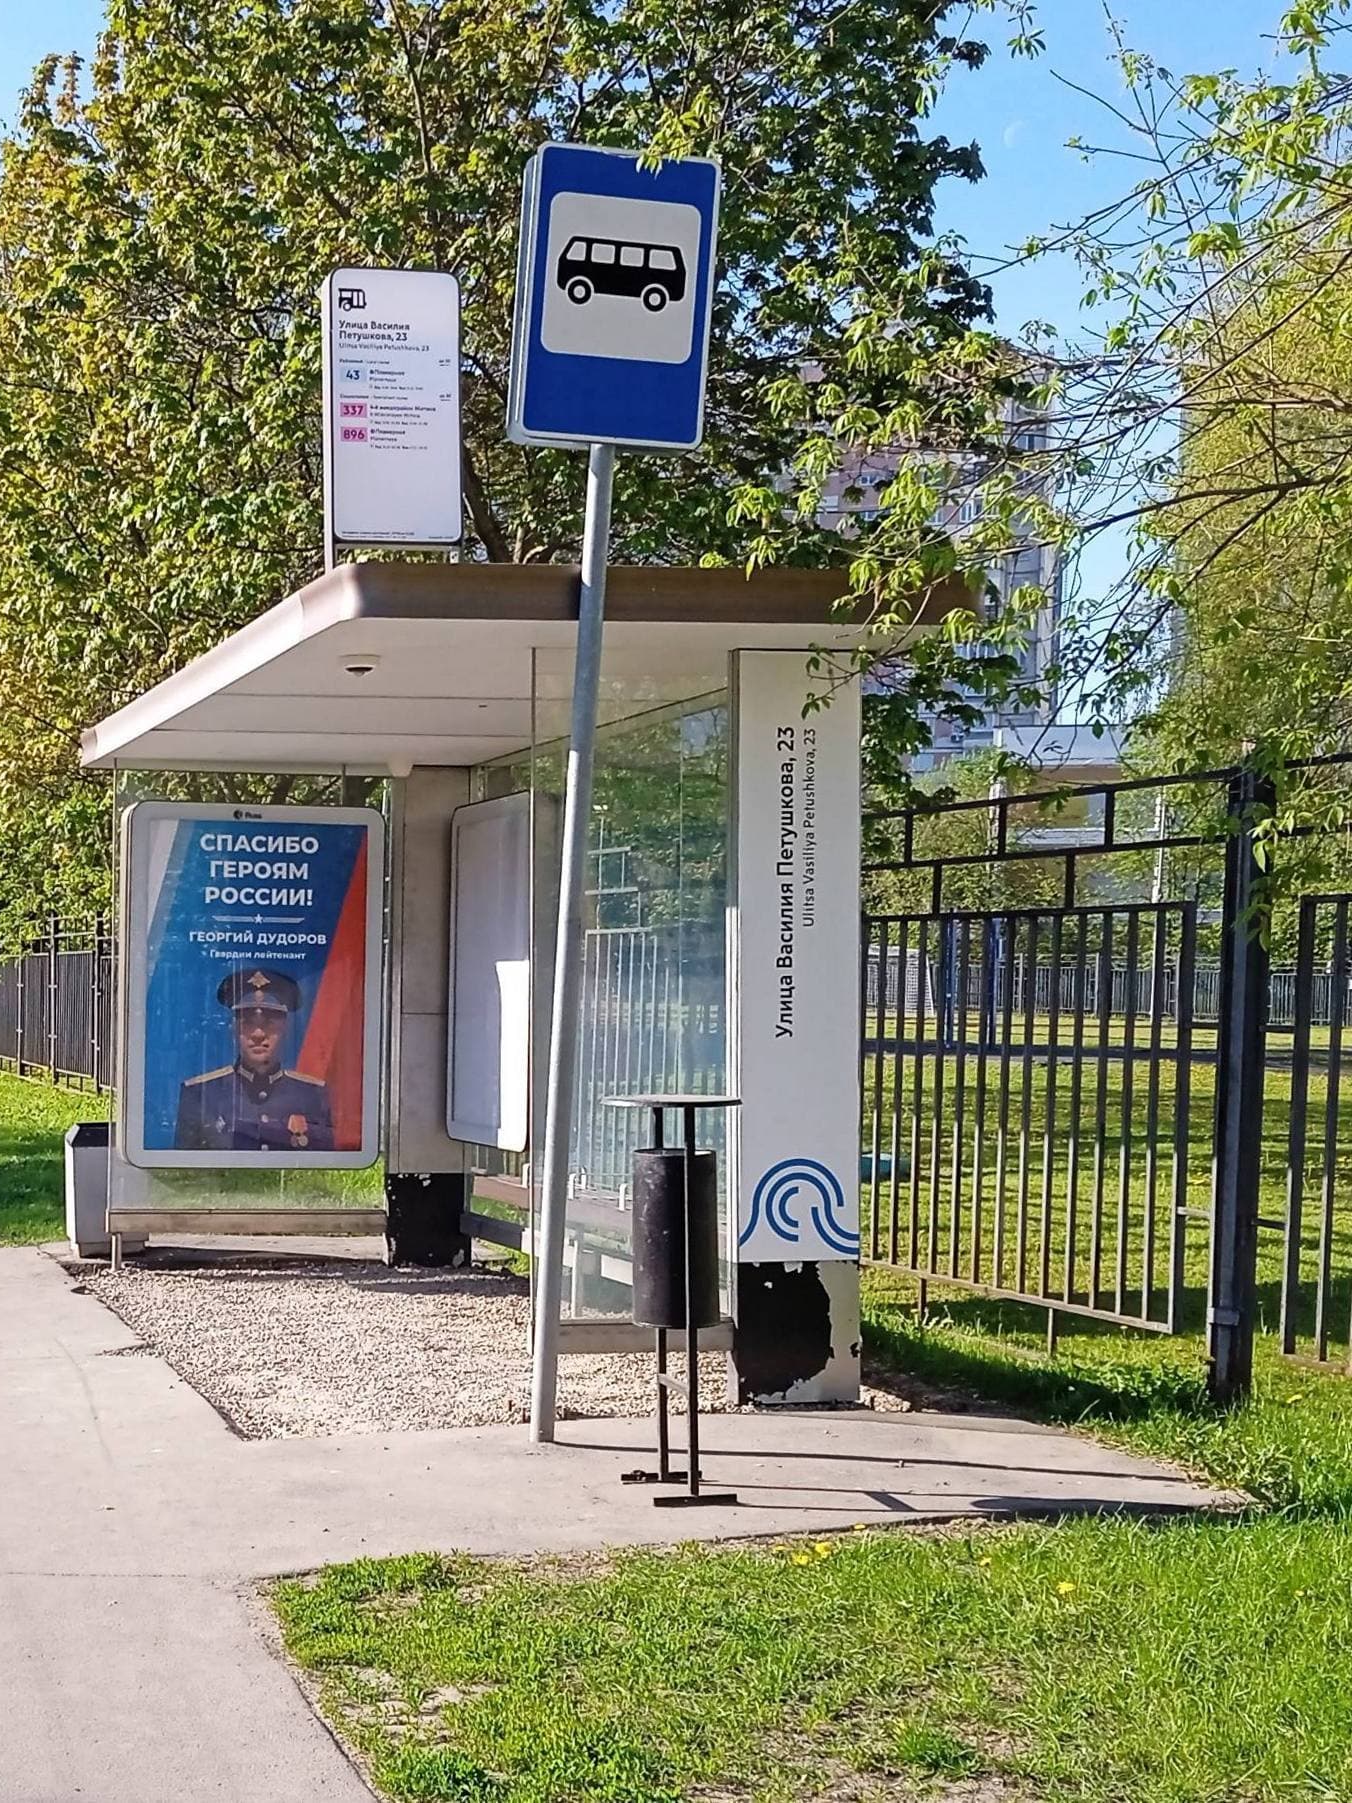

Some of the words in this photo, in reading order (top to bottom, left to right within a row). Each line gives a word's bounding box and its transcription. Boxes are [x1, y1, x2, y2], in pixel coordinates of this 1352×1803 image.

[339, 320, 368, 330] Улица
[370, 321, 410, 330] Василия
[339, 330, 394, 342] Петушкова,
[395, 332, 408, 341] 23
[346, 370, 360, 380] 43
[343, 405, 364, 416] 337
[343, 429, 365, 440] 896
[777, 727, 794, 752] 23
[804, 728, 816, 745] 23
[803, 748, 817, 828] Petushkova,
[776, 757, 797, 876] Петушкова,
[200, 833, 319, 854] СПАСИБО
[802, 832, 817, 884] Vasiliya
[210, 860, 309, 880] ГЕРОЯМ
[205, 886, 313, 907] РОССИИ!
[802, 888, 815, 927] Ulitsa
[776, 883, 794, 968] Василия
[189, 930, 253, 943] ГЕОРГИЙ
[256, 932, 327, 945] ДУДОРОВ
[210, 949, 252, 960] Гвардии
[254, 951, 306, 960] лейтенант
[775, 975, 795, 1038] Улица
